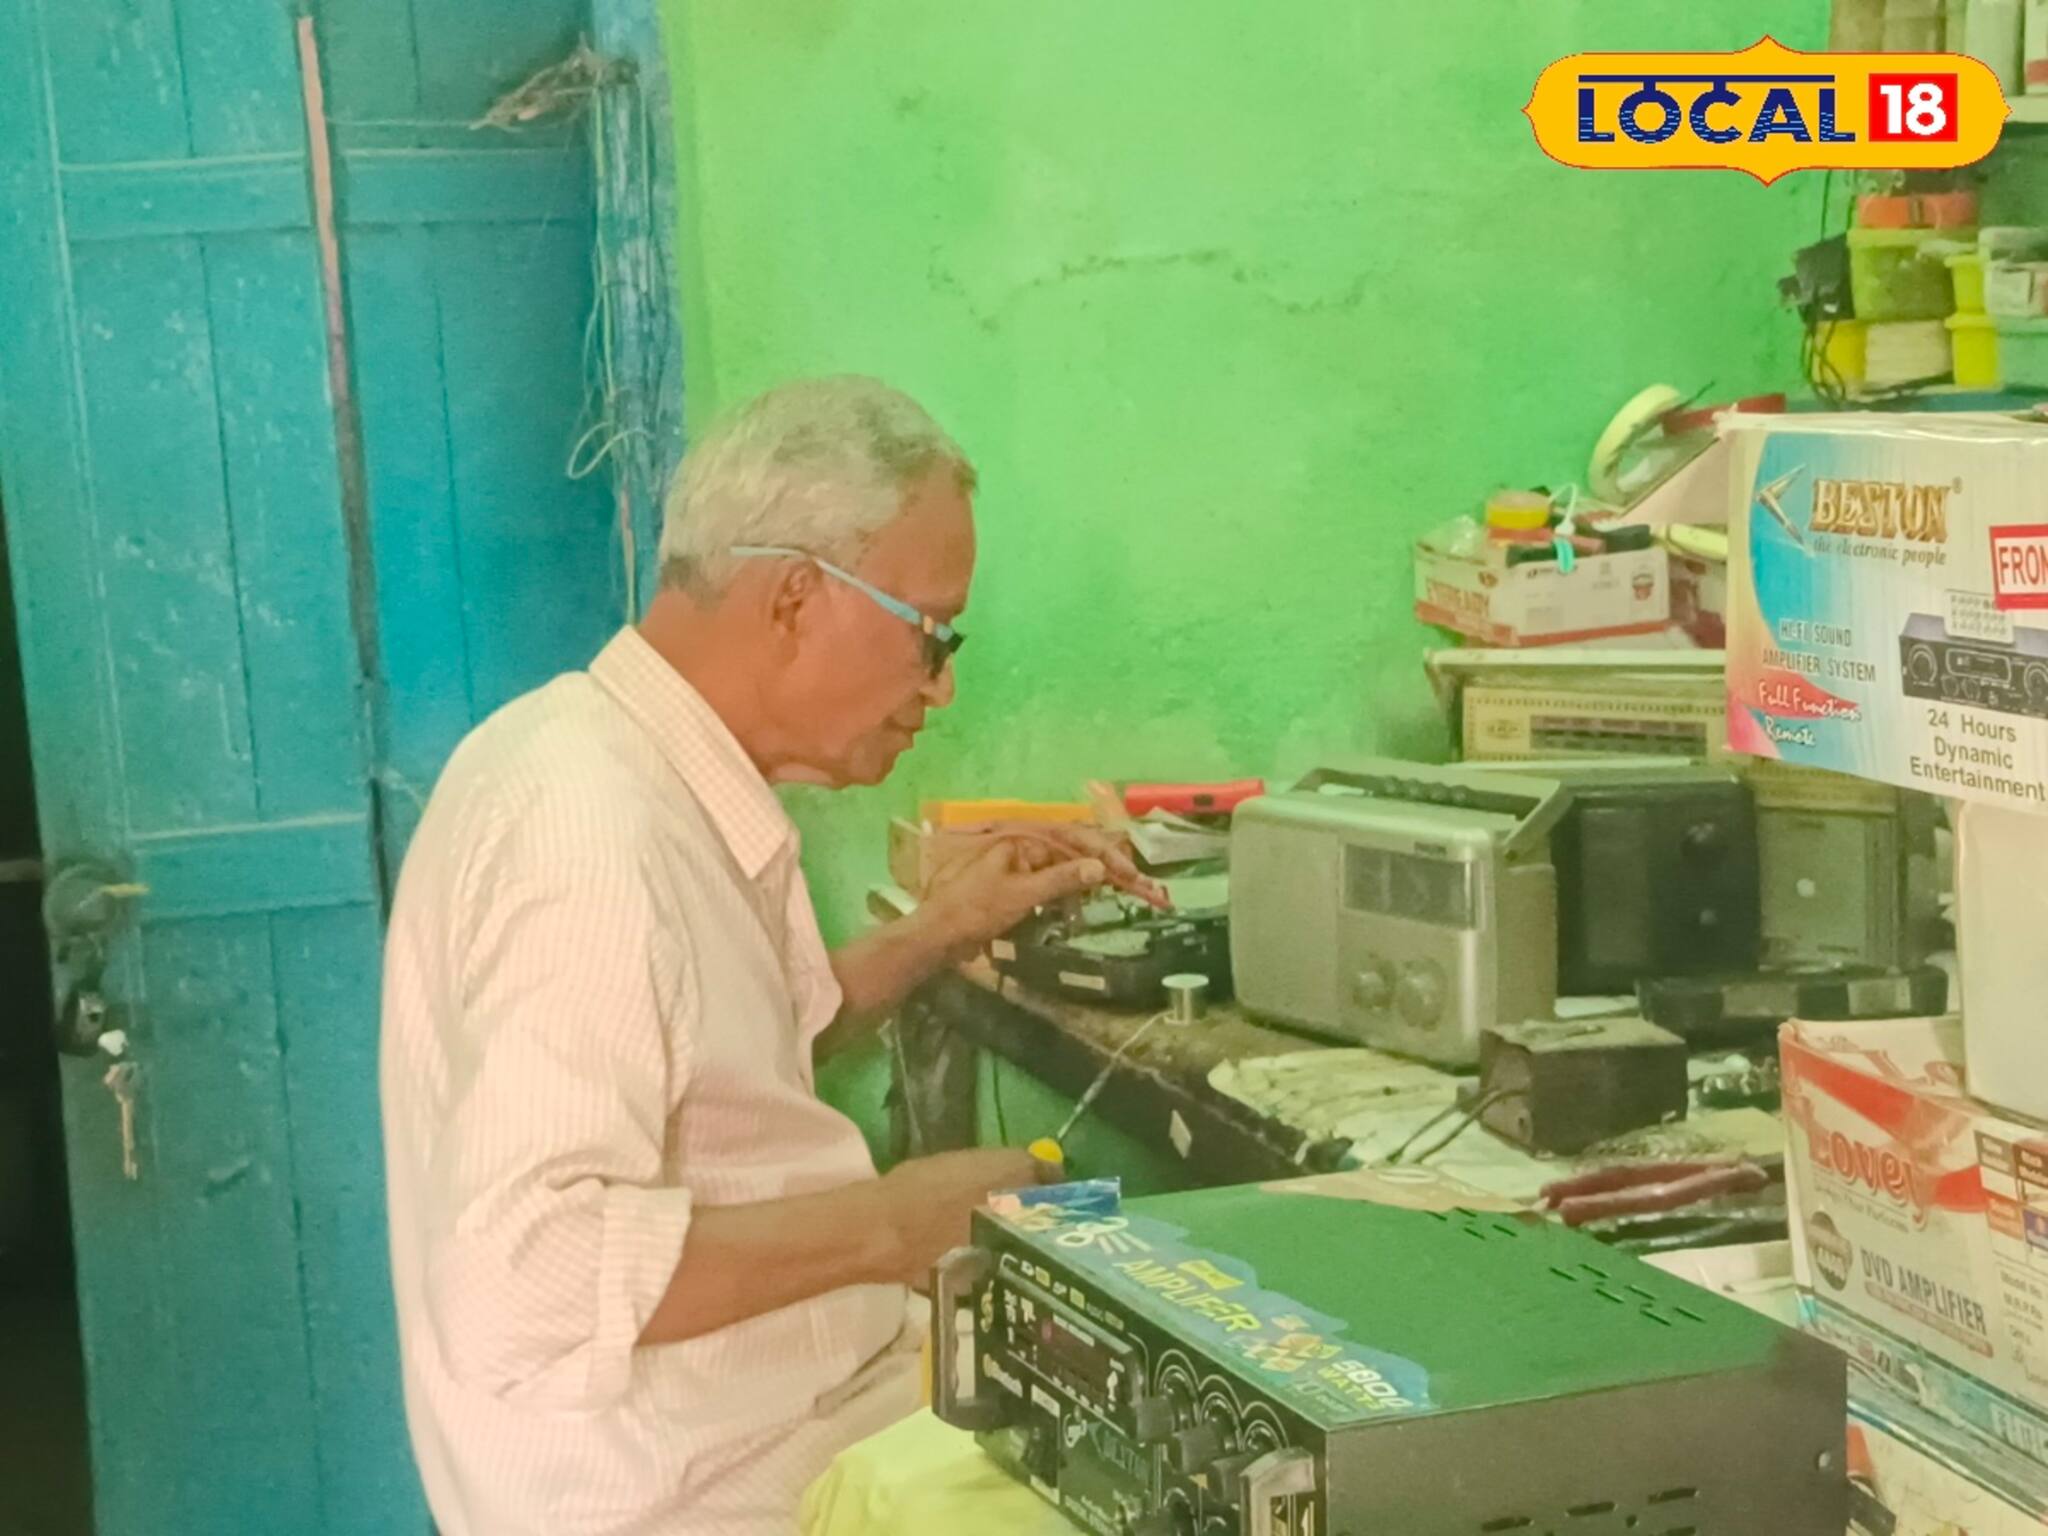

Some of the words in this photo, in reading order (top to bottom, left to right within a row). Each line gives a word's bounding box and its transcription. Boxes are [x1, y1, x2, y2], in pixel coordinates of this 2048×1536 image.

[1810, 479, 1950, 543] BESTON
[1814, 537, 1831, 553] the
[1836, 539, 1898, 560] electronic
[1901, 547, 1947, 568] people
[1814, 624, 1852, 647] SOUND
[1763, 648, 1820, 673] AMPLIFIER
[1827, 658, 1876, 682] SYSTEM
[1759, 680, 1791, 708] Full
[1764, 714, 1816, 747] Remote
[1928, 708, 1949, 728] 24
[1961, 713, 2016, 743] Hours
[1934, 735, 2014, 769] Dynamic
[1910, 756, 2046, 802] Entertainment
[1860, 1248, 1893, 1288] DVD
[1899, 1266, 1987, 1337] AMPLIFIER
